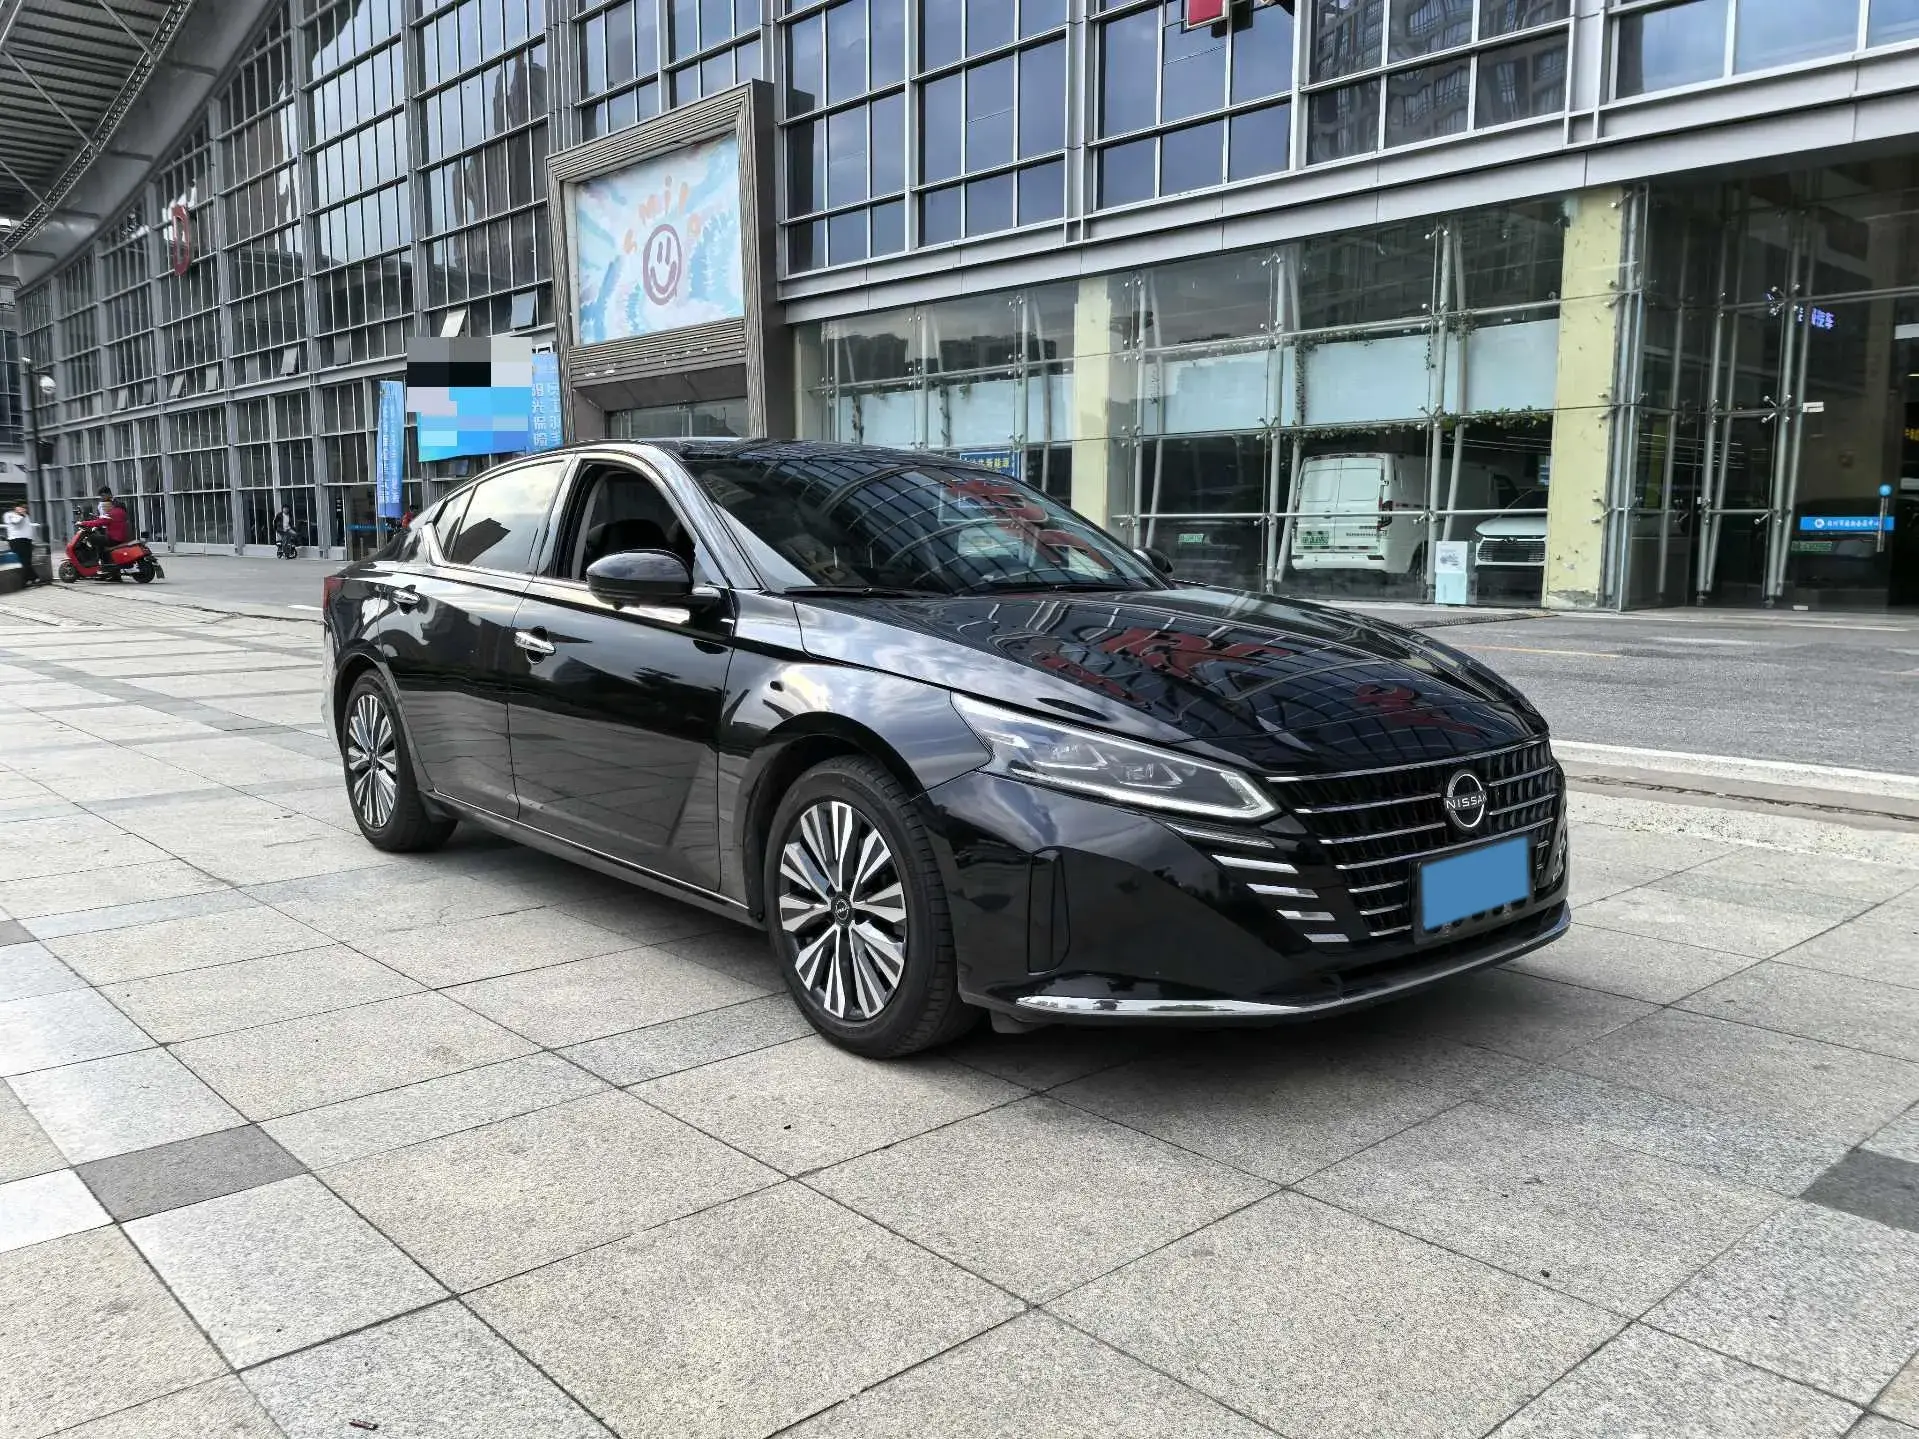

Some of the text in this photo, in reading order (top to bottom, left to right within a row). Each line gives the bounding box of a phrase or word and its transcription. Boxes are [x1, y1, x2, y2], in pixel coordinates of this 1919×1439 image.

[531, 383, 548, 447] 阳光保险
[1446, 792, 1487, 809] NISSAN
